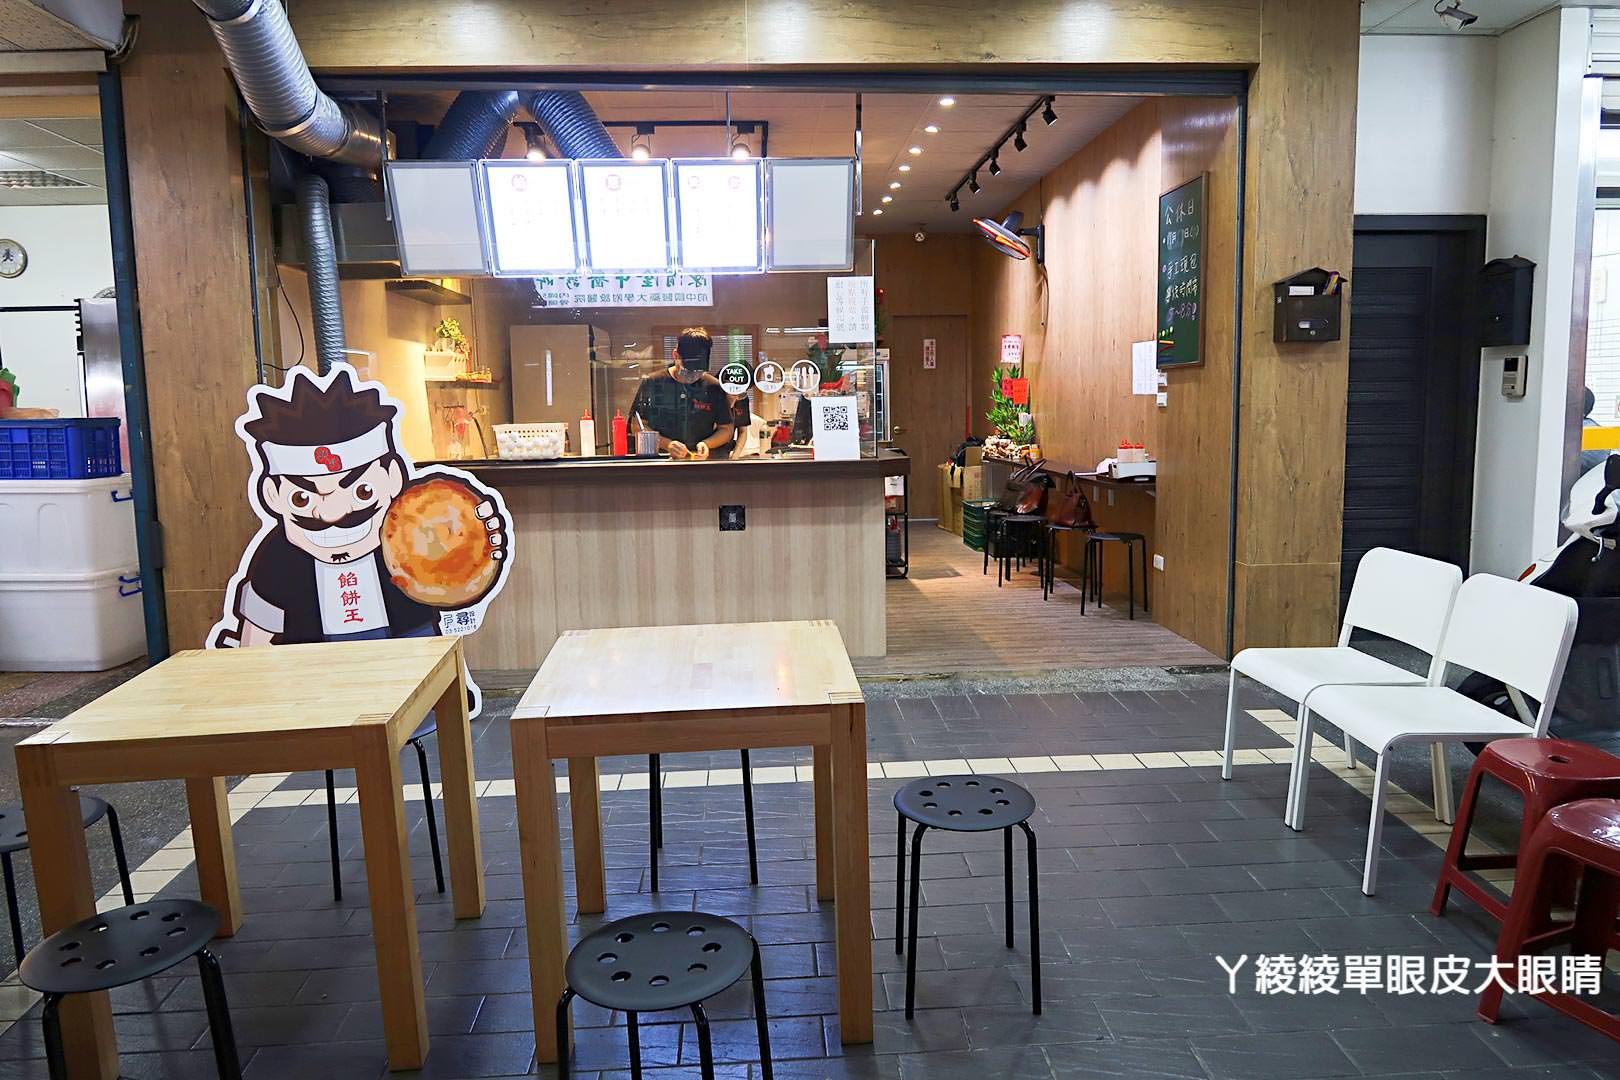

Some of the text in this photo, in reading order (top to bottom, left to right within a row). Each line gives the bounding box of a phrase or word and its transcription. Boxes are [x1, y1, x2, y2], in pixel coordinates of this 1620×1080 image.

[1165, 200, 1195, 225] 公休日
[729, 375, 744, 383] OUT
[337, 572, 364, 624] 餡餅王
